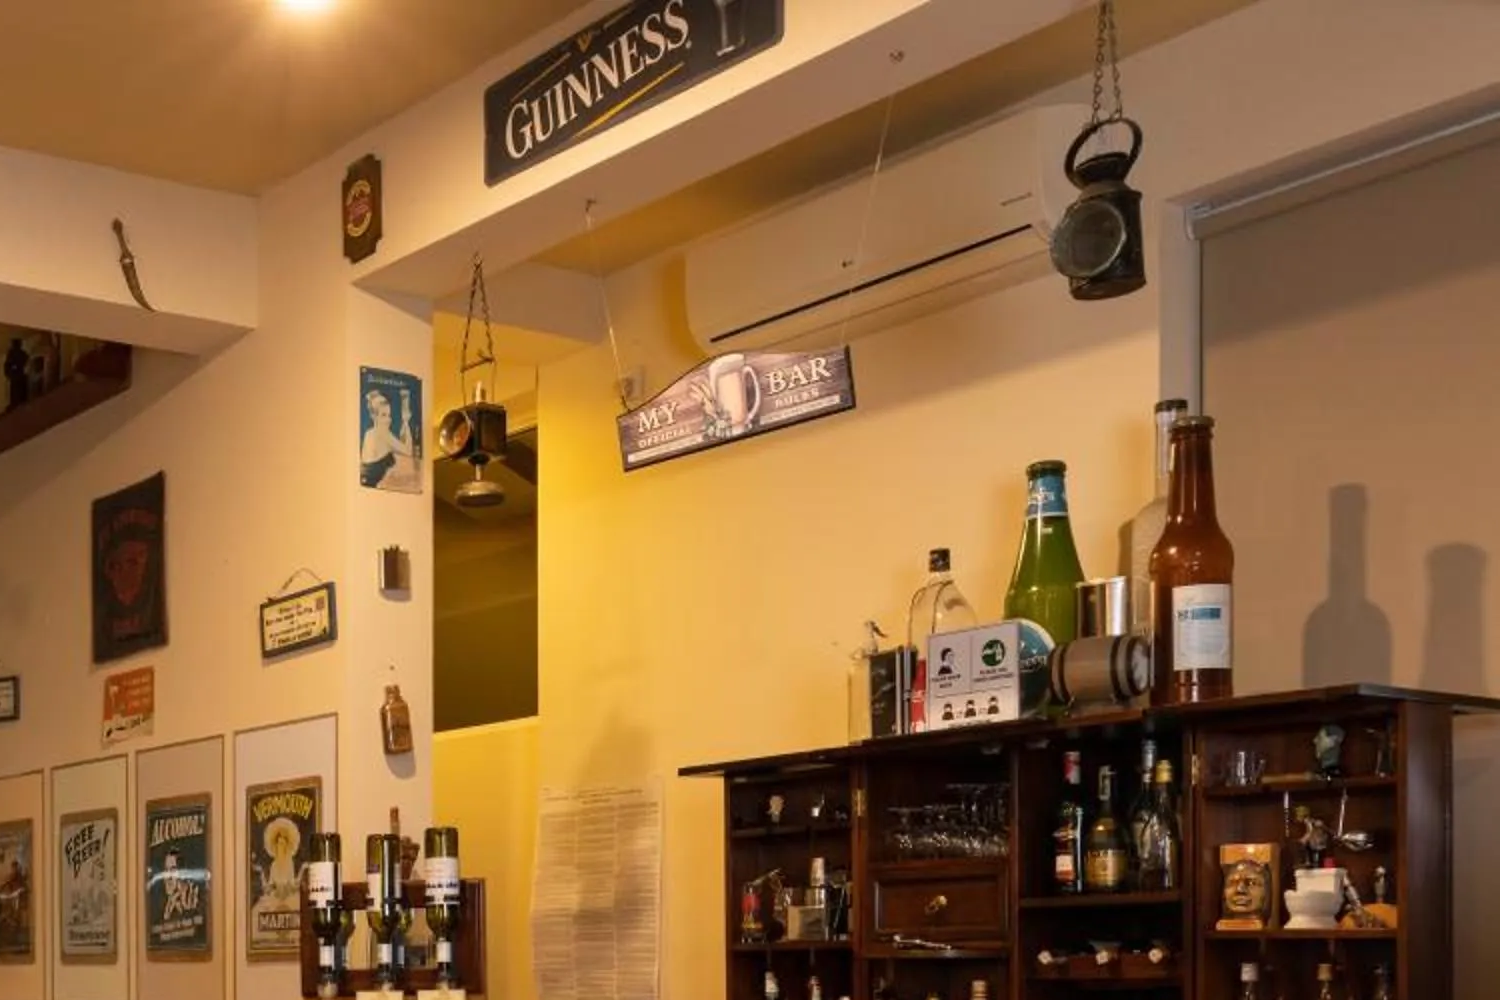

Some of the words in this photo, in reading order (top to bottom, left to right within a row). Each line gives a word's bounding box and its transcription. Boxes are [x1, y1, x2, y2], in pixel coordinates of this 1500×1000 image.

[505, 0, 691, 160] GUINNESS
[637, 401, 679, 433] MY
[766, 357, 832, 396] BAR
